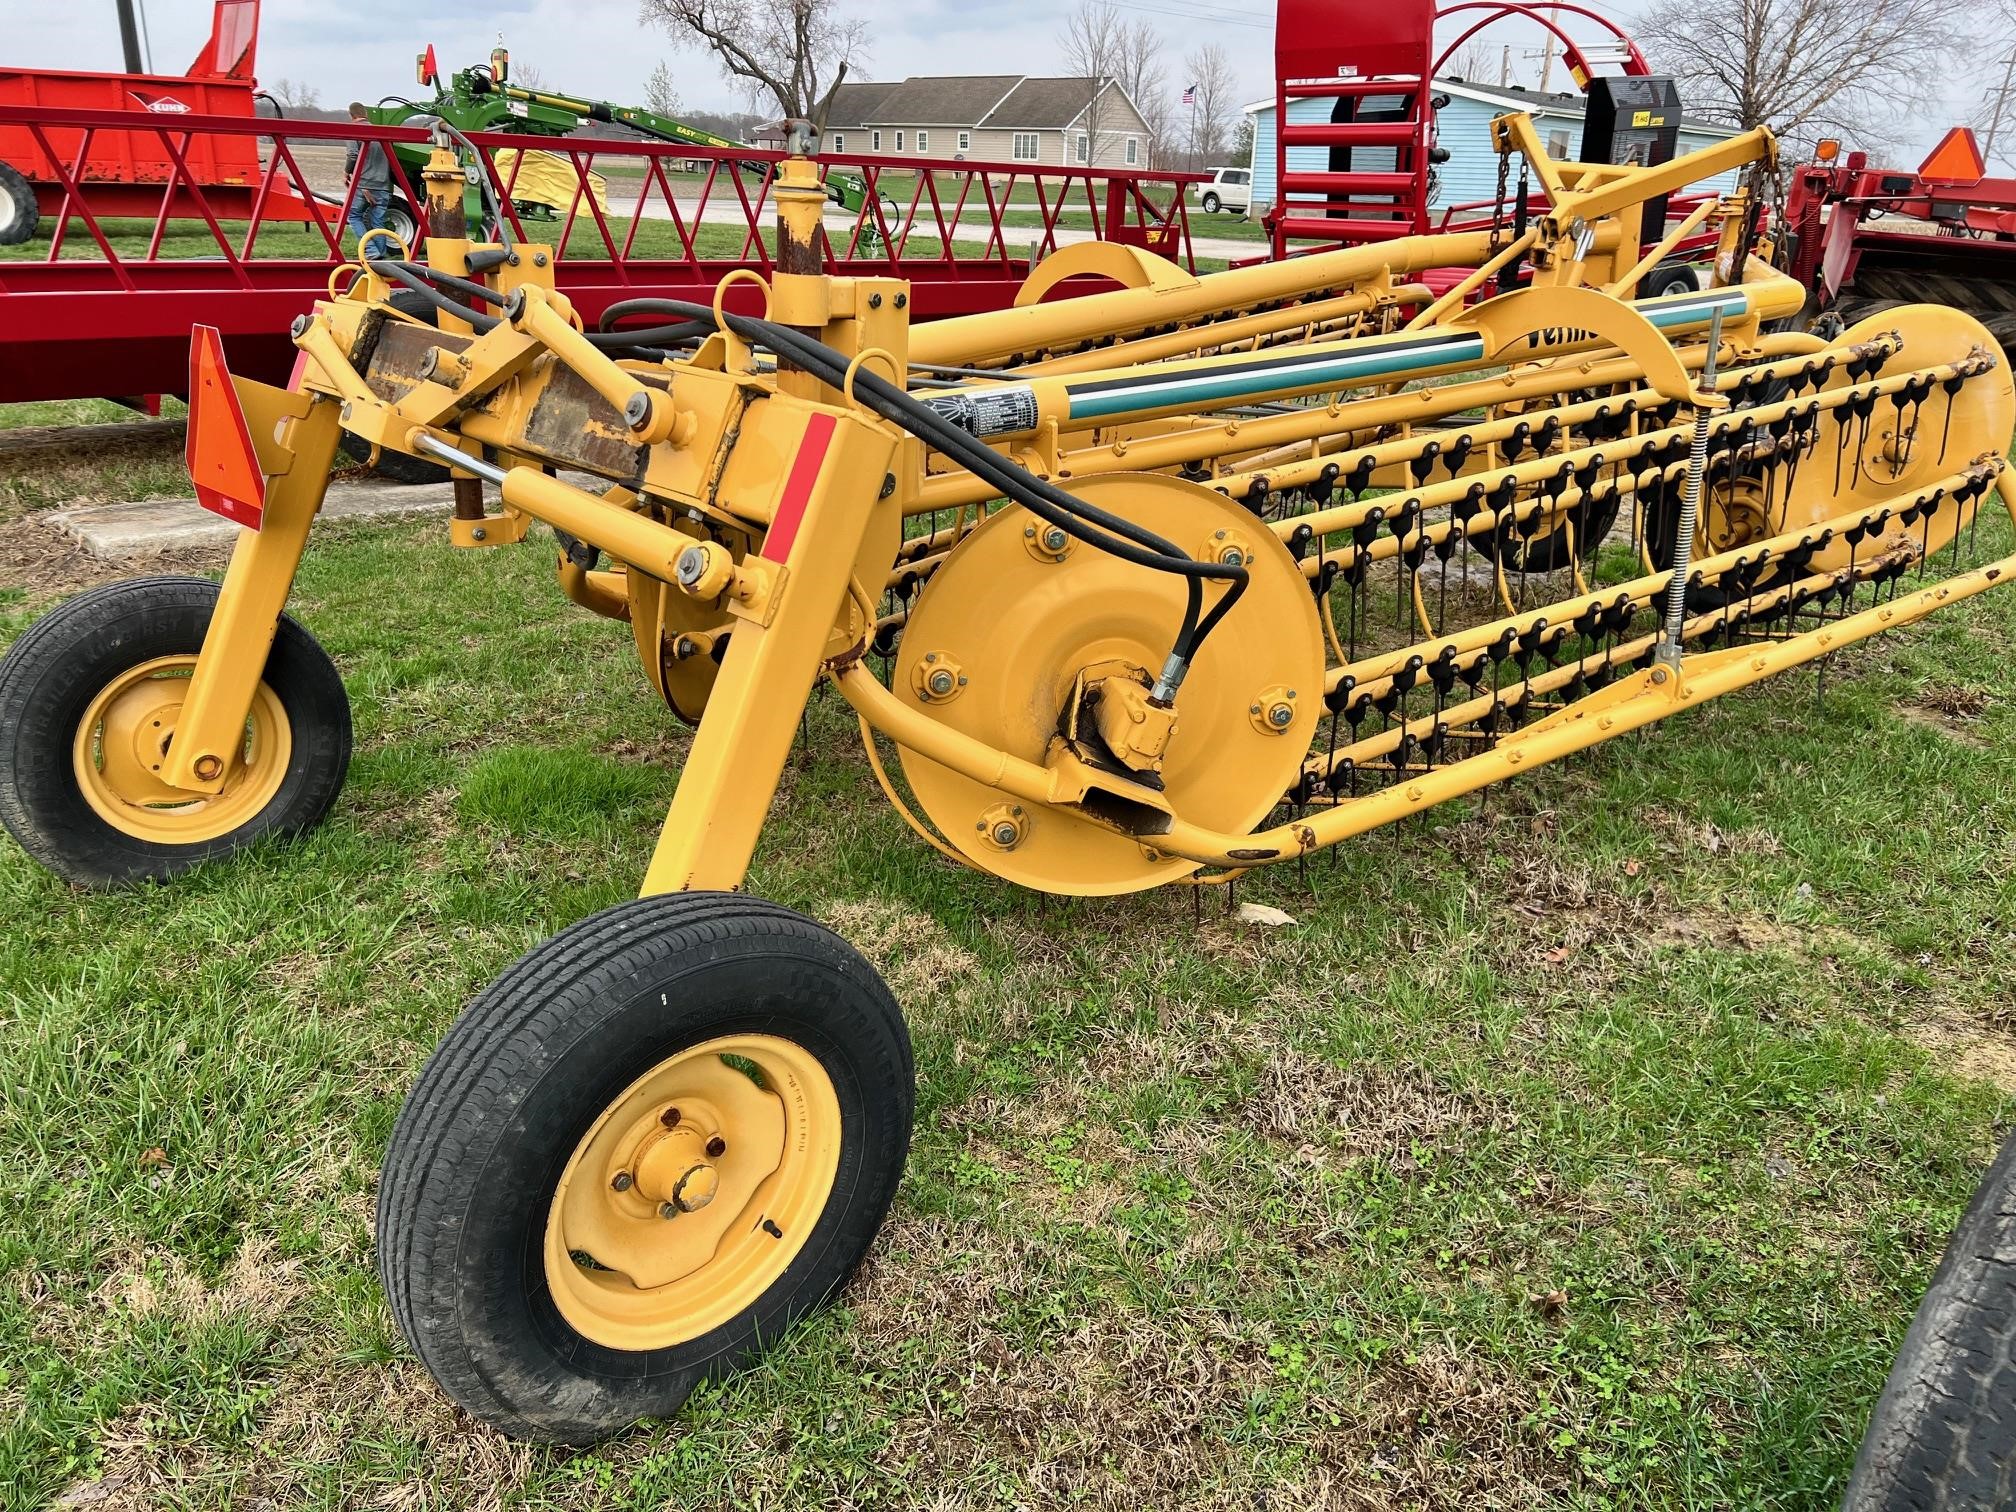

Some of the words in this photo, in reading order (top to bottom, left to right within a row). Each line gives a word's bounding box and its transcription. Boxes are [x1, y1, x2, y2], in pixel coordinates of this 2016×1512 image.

[152, 103, 186, 112] KUHN
[676, 126, 697, 137] EASY
[843, 1003, 896, 1088] TRAILER
